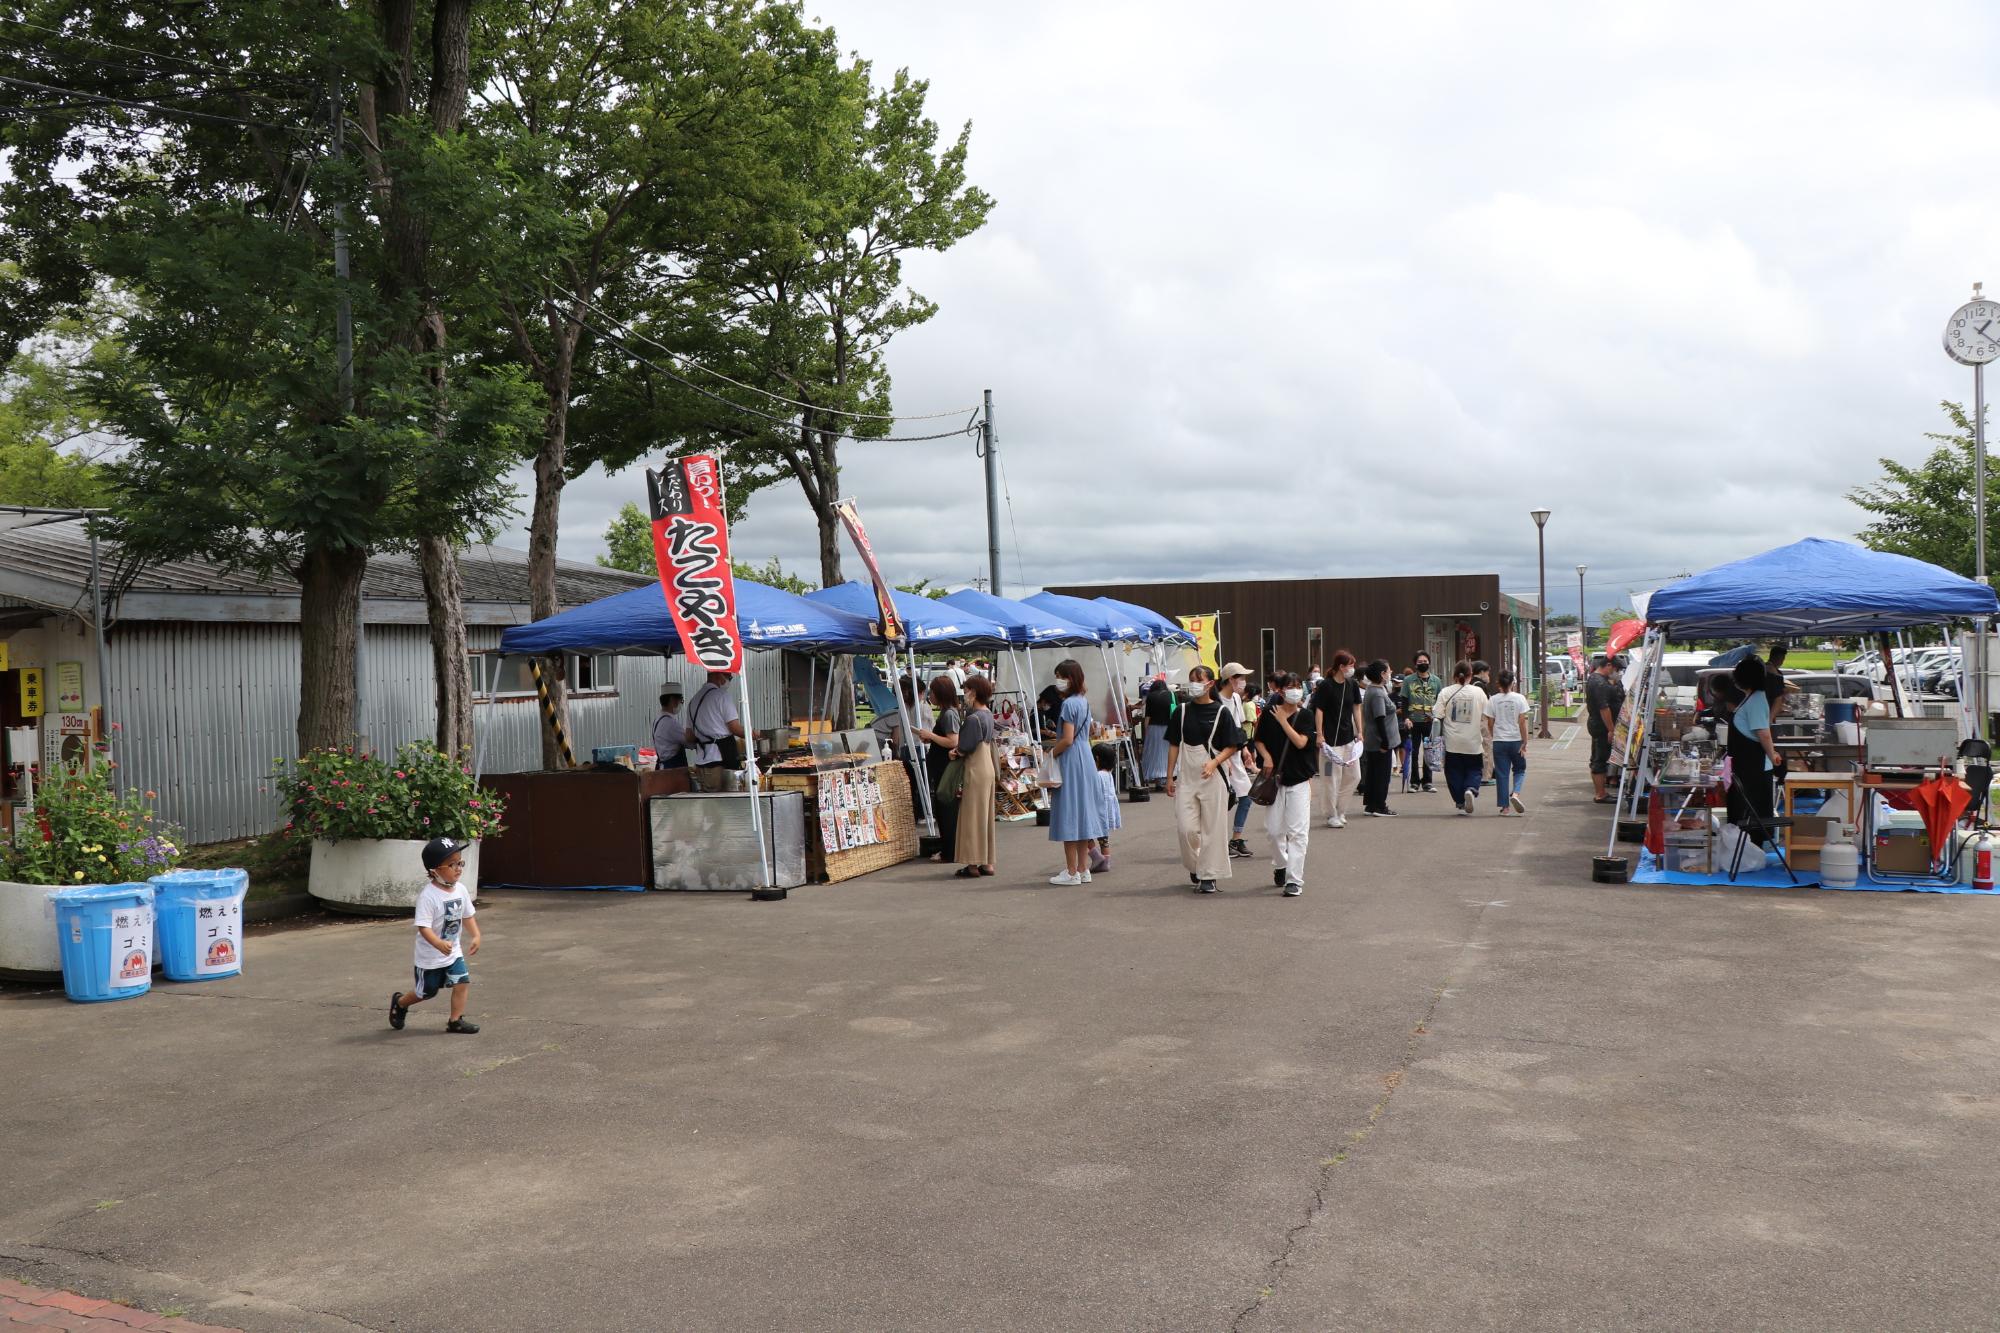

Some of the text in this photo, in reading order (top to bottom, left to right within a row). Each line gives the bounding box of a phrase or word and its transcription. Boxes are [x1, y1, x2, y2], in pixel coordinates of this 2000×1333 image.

[1965, 310, 1973, 319] 11
[1976, 307, 1986, 316] 12
[1953, 319, 1965, 328] 10
[1953, 329, 1960, 338] 9
[1957, 338, 1965, 347] 8
[1967, 346, 1973, 354] 7
[1977, 347, 1984, 356] 6
[1988, 344, 1996, 353] 5
[653, 474, 669, 516] ソース
[667, 468, 683, 512] こだわり
[664, 516, 735, 670] たこやき
[26, 672, 38, 712] 乗車券
[199, 905, 239, 918] 燃える
[115, 913, 151, 928] 燃える
[208, 925, 234, 938] ゴミ
[124, 935, 147, 948] ゴミ
